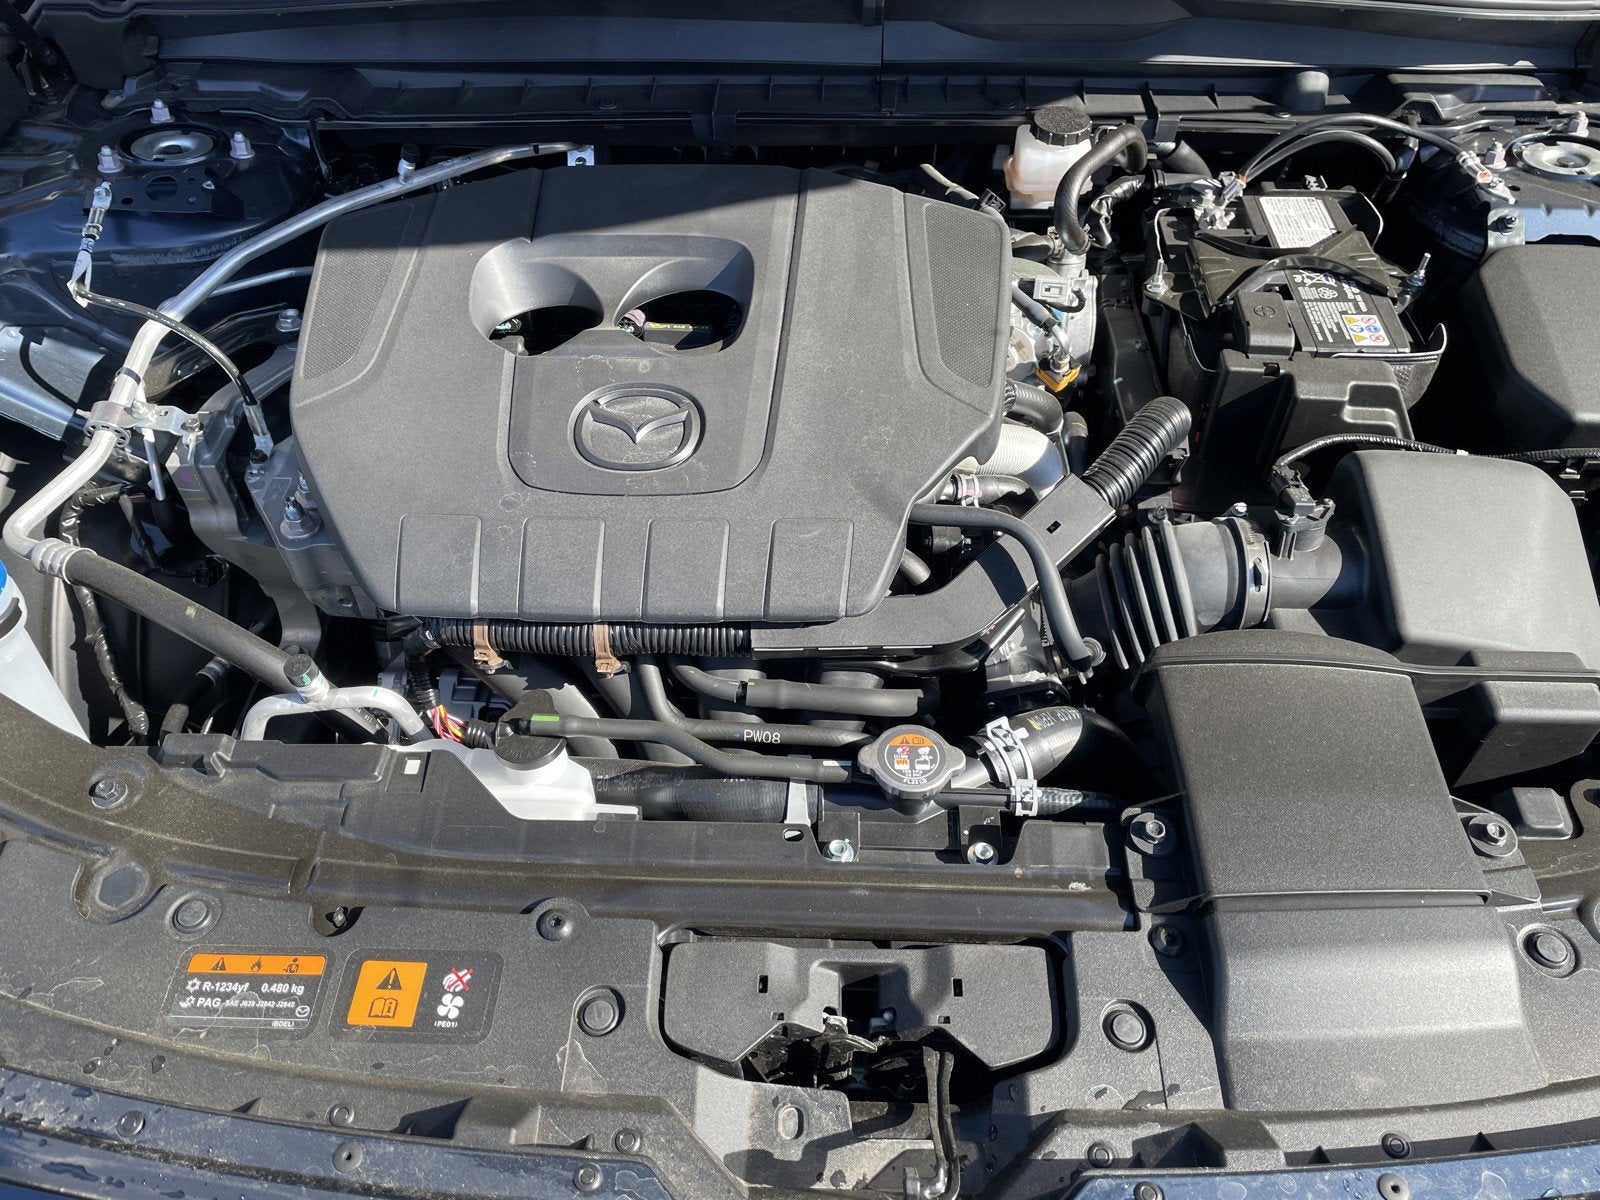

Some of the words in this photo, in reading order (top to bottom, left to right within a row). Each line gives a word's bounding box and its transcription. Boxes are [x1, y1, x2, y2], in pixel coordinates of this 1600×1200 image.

[743, 729, 781, 744] PW08
[202, 981, 250, 993] R-1234yf
[261, 982, 289, 993] 0.480
[290, 983, 305, 996] kg
[196, 997, 221, 1008] PAG
